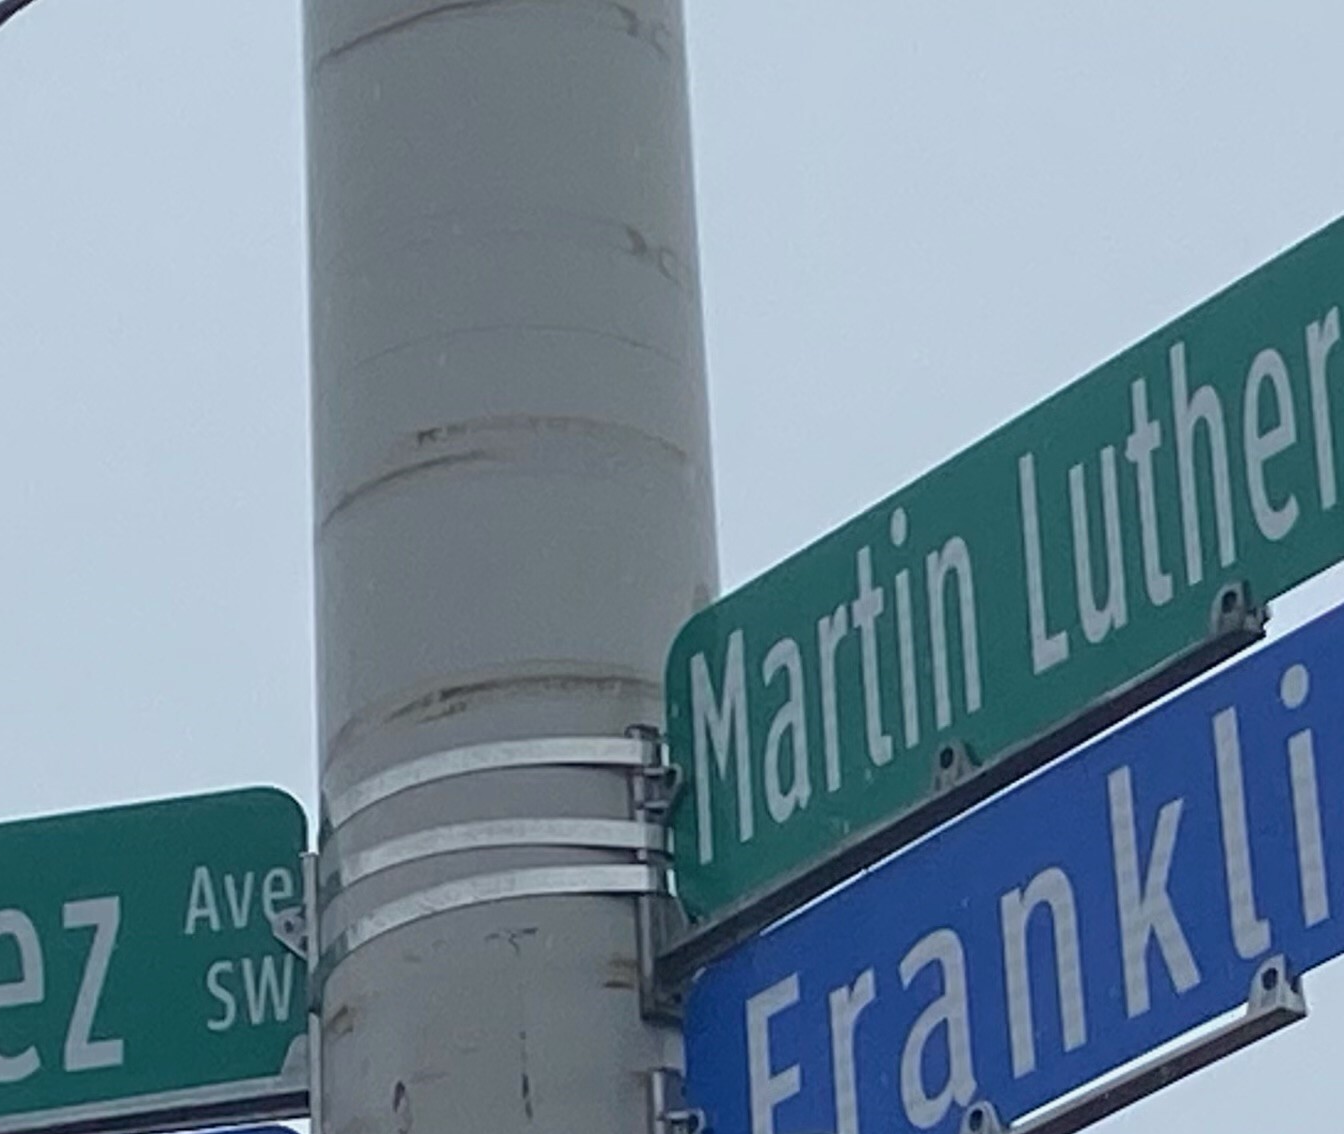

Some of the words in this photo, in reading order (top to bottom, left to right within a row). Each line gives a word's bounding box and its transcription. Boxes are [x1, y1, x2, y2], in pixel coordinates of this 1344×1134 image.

[690, 506, 981, 865] Martin
[1019, 304, 1341, 675] Luther
[184, 865, 296, 935] Ave
[206, 953, 294, 1032] SW
